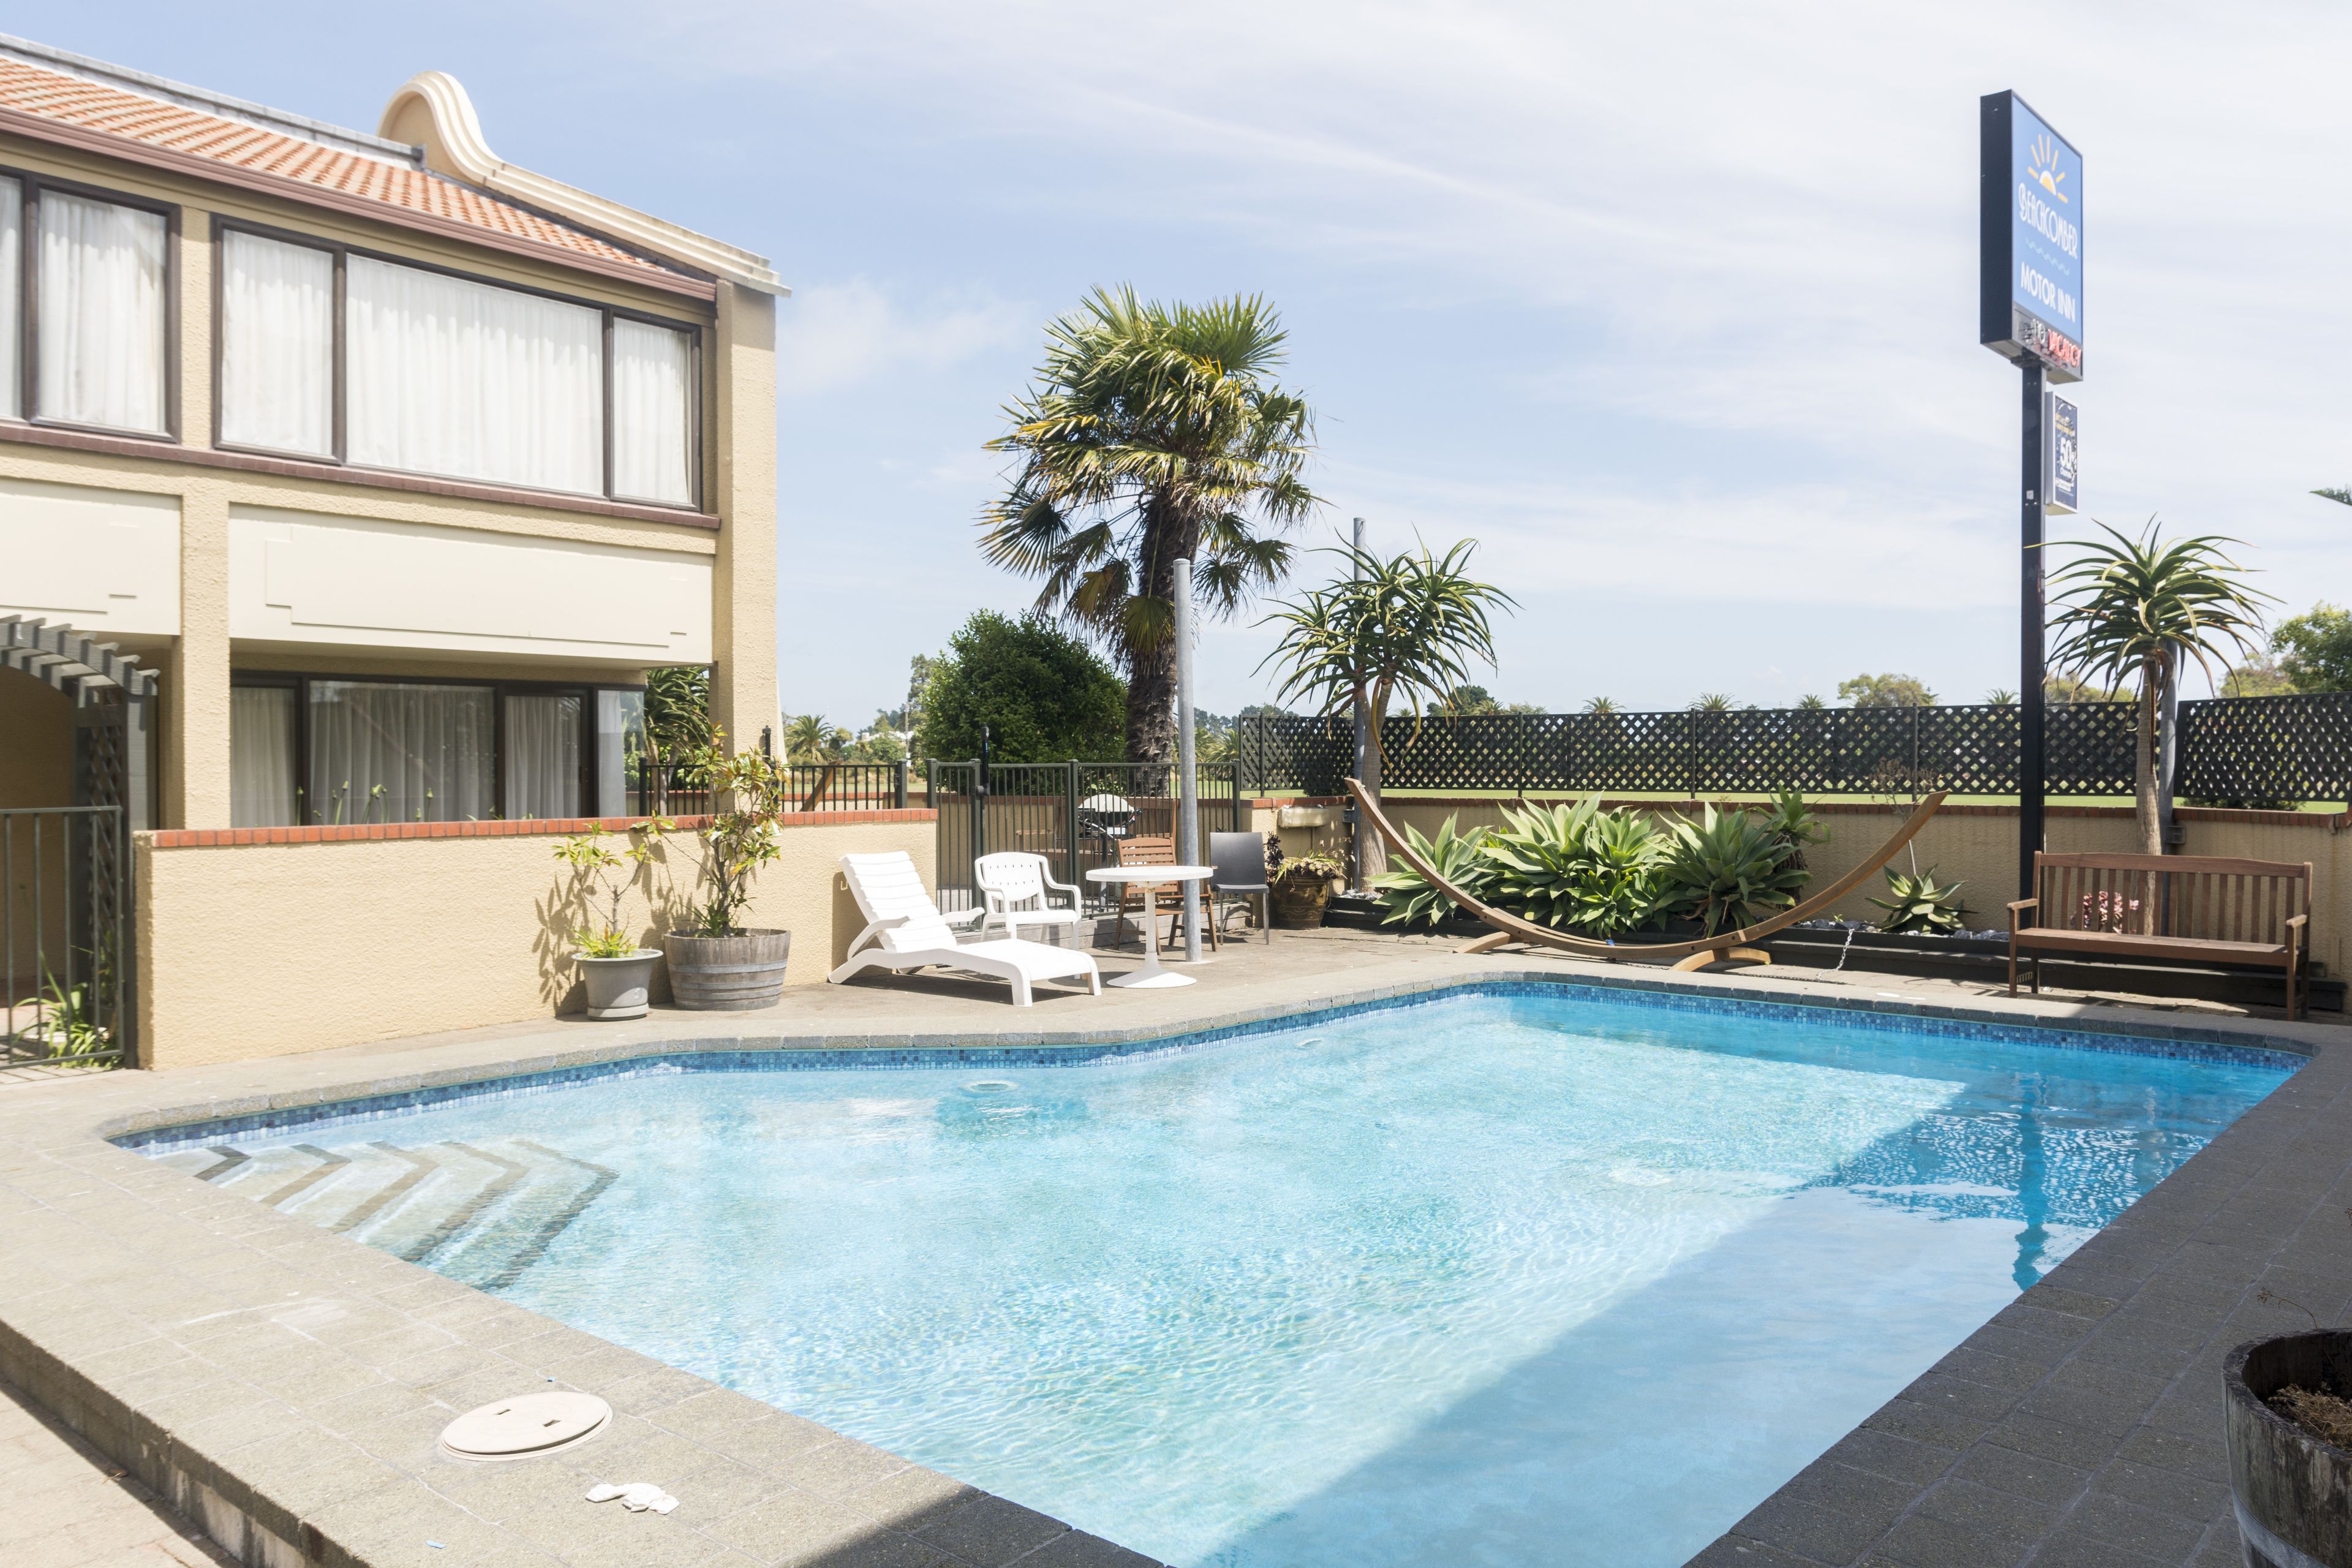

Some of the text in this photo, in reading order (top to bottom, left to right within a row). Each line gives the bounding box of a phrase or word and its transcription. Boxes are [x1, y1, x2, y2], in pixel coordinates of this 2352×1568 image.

[2018, 183, 2078, 260] BEACHCOMBER
[2021, 262, 2076, 323] MOTOR INN
